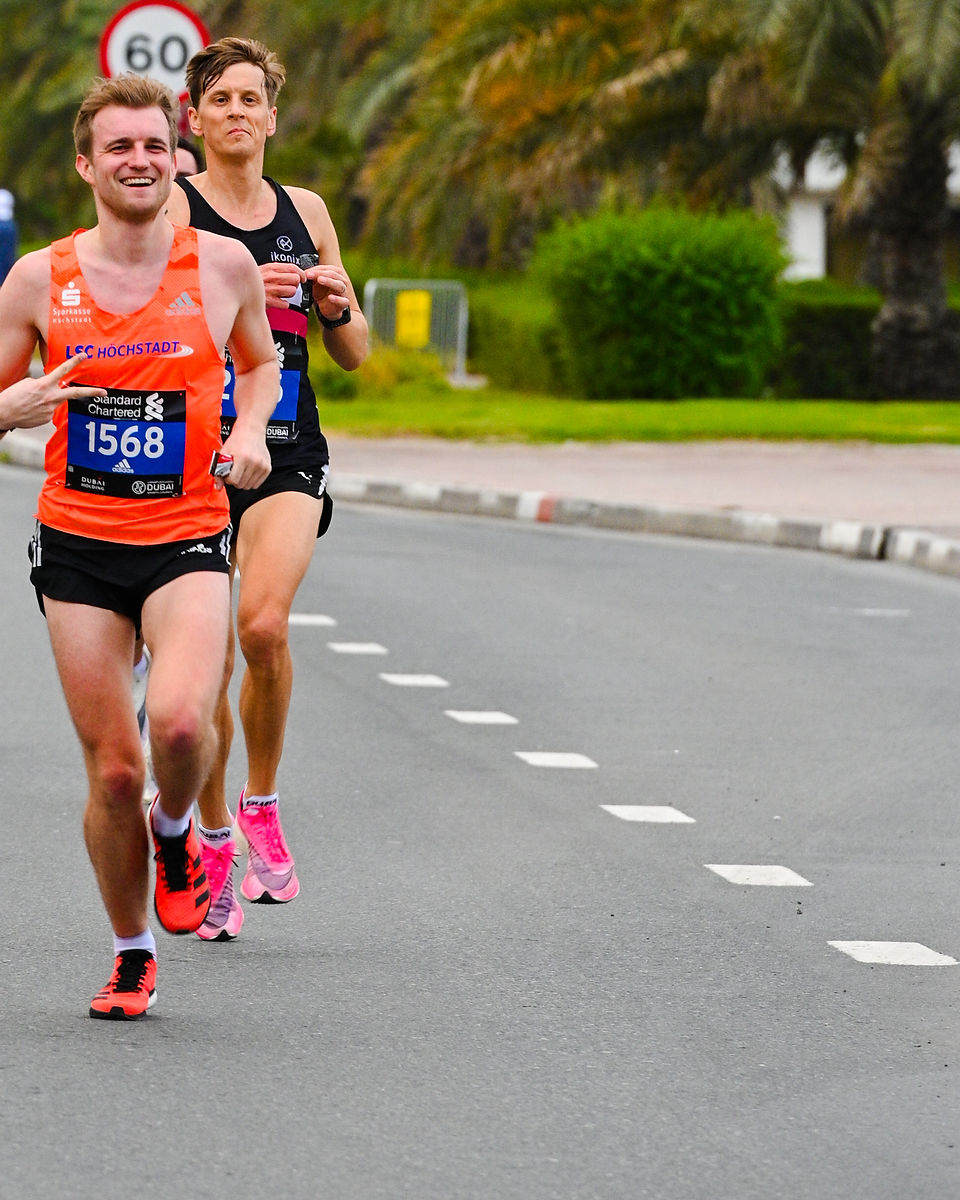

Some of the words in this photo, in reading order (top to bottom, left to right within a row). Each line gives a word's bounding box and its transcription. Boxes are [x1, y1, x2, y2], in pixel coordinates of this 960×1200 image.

[125, 34, 189, 72] 60
[270, 251, 301, 265] ikonix
[65, 344, 94, 360] LSC
[97, 341, 180, 359] HÖCHSTADT
[88, 403, 141, 418] Chartered
[85, 421, 165, 459] 1568
[81, 476, 106, 486] DUBAI
[147, 483, 174, 491] DUBAI
